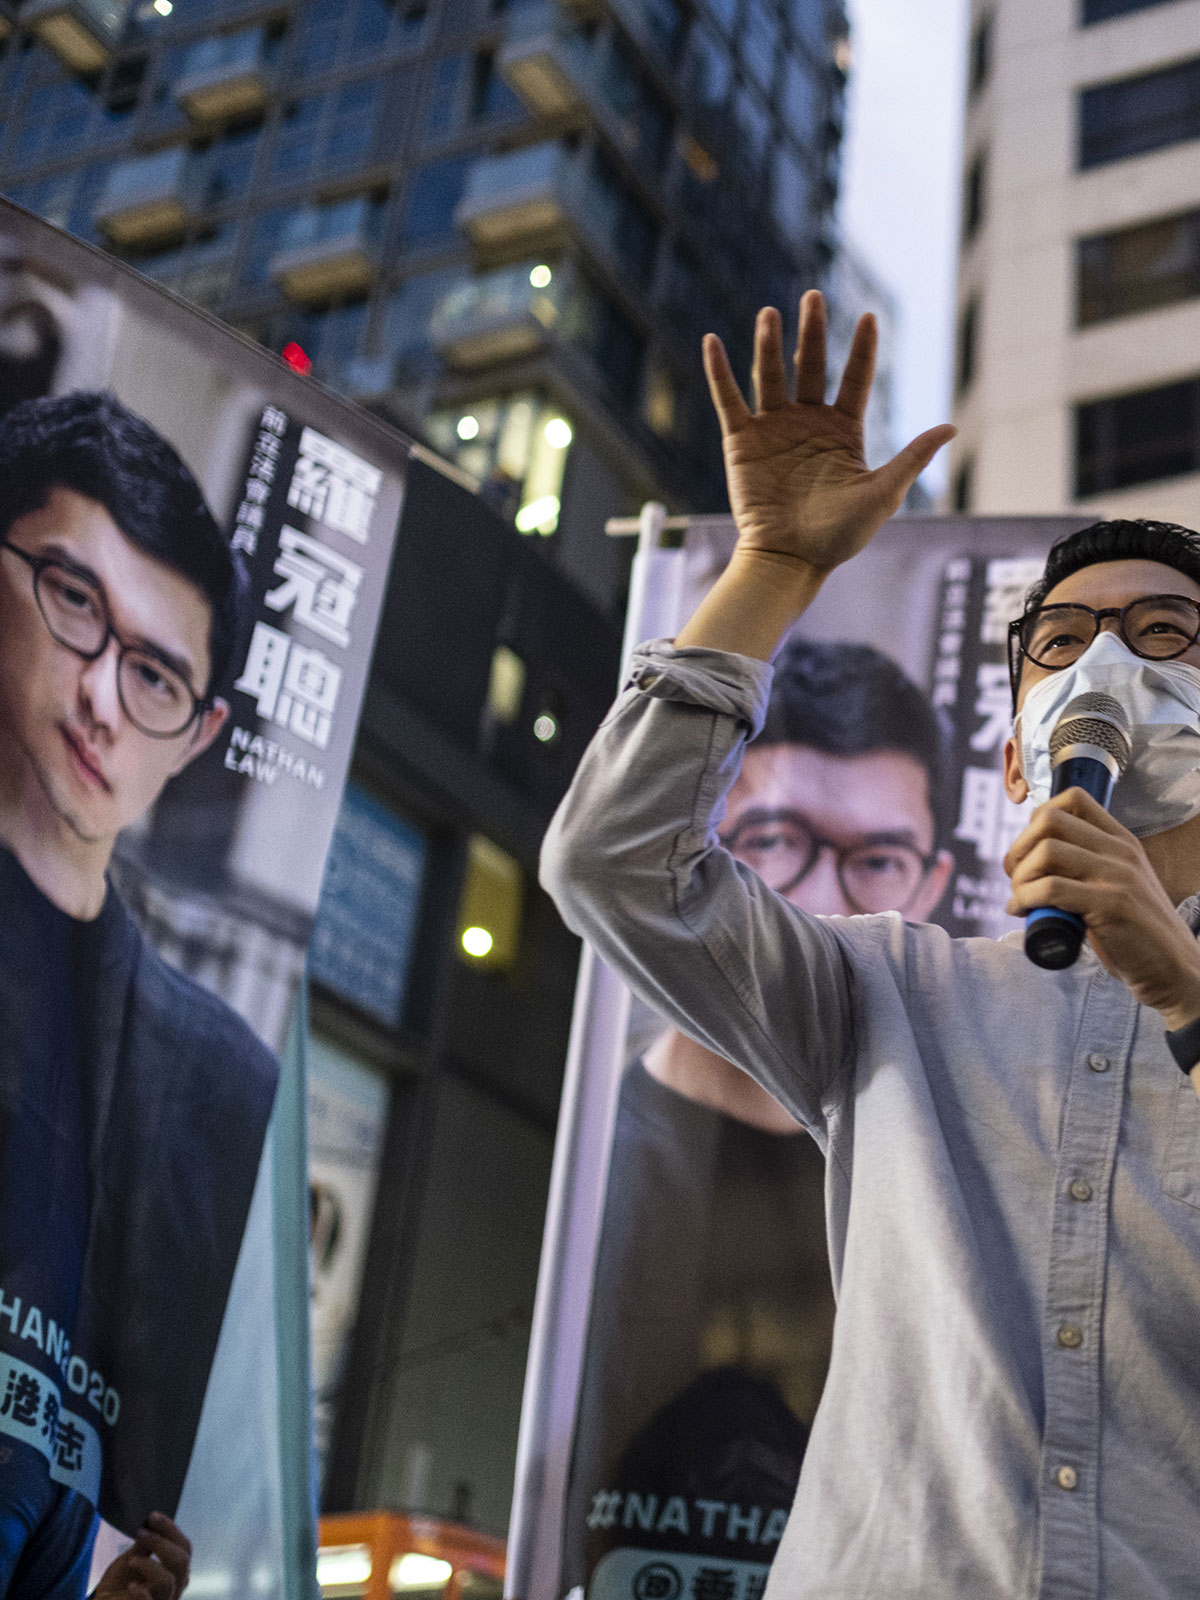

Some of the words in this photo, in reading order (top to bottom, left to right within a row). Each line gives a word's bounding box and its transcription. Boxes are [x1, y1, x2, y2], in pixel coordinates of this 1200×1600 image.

[235, 425, 383, 750] 羅冠聰
[224, 747, 278, 784] LAW
[230, 726, 324, 789] NATHAN
[586, 1490, 792, 1545] #NATHA
